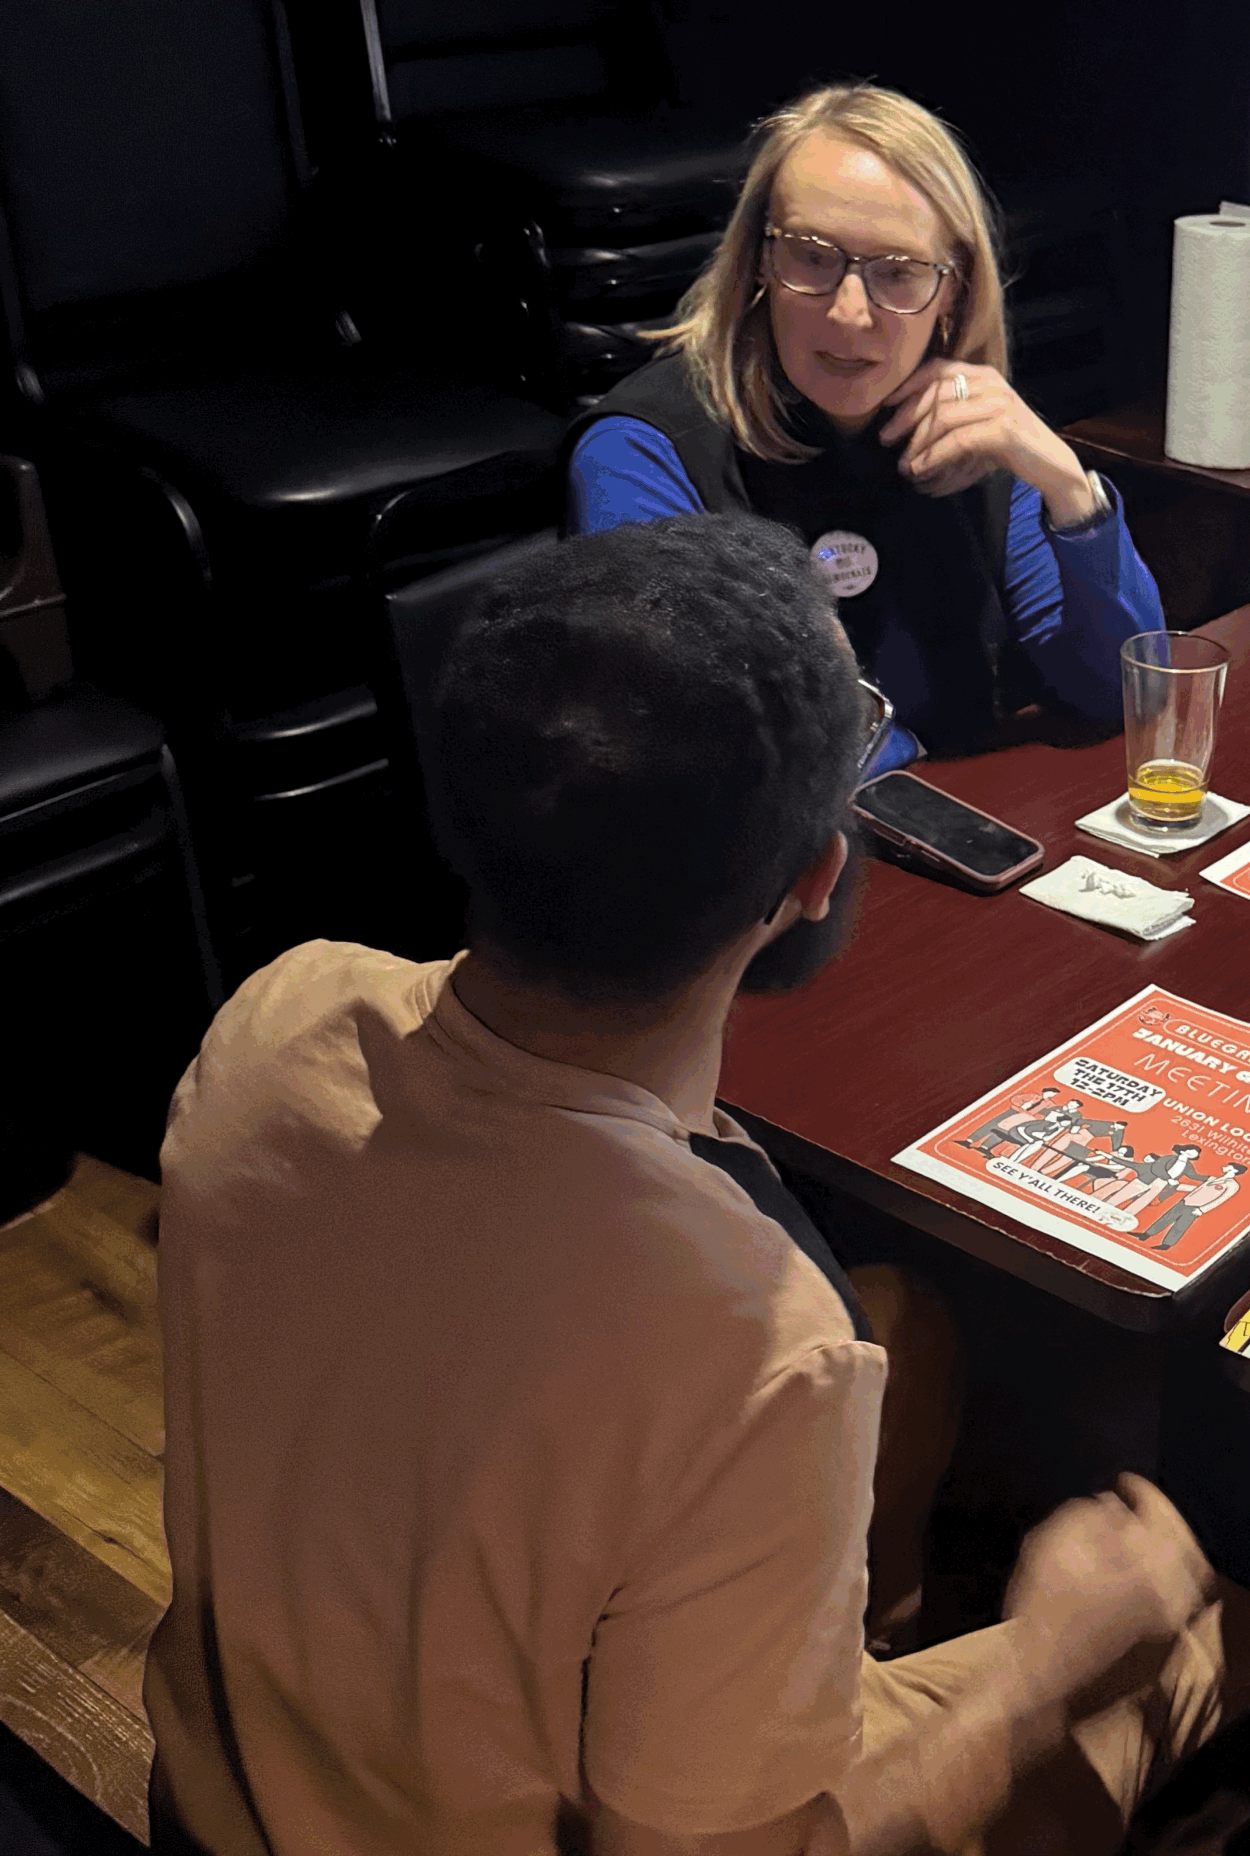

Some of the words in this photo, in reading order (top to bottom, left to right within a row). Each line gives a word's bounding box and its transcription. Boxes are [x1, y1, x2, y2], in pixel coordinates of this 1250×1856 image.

[1132, 1027, 1238, 1074] JANUARY
[1069, 1078, 1130, 1106] 12-2PM
[1074, 1058, 1164, 1098] SATURDAY
[1074, 1068, 1106, 1088] THE
[1107, 1081, 1151, 1103] 17TH
[1163, 1097, 1220, 1127] UNION
[1171, 1115, 1204, 1133] 2631
[993, 1161, 1019, 1177] SEE
[1019, 1173, 1052, 1194] Y'ALL
[1052, 1189, 1101, 1214] THERE!
